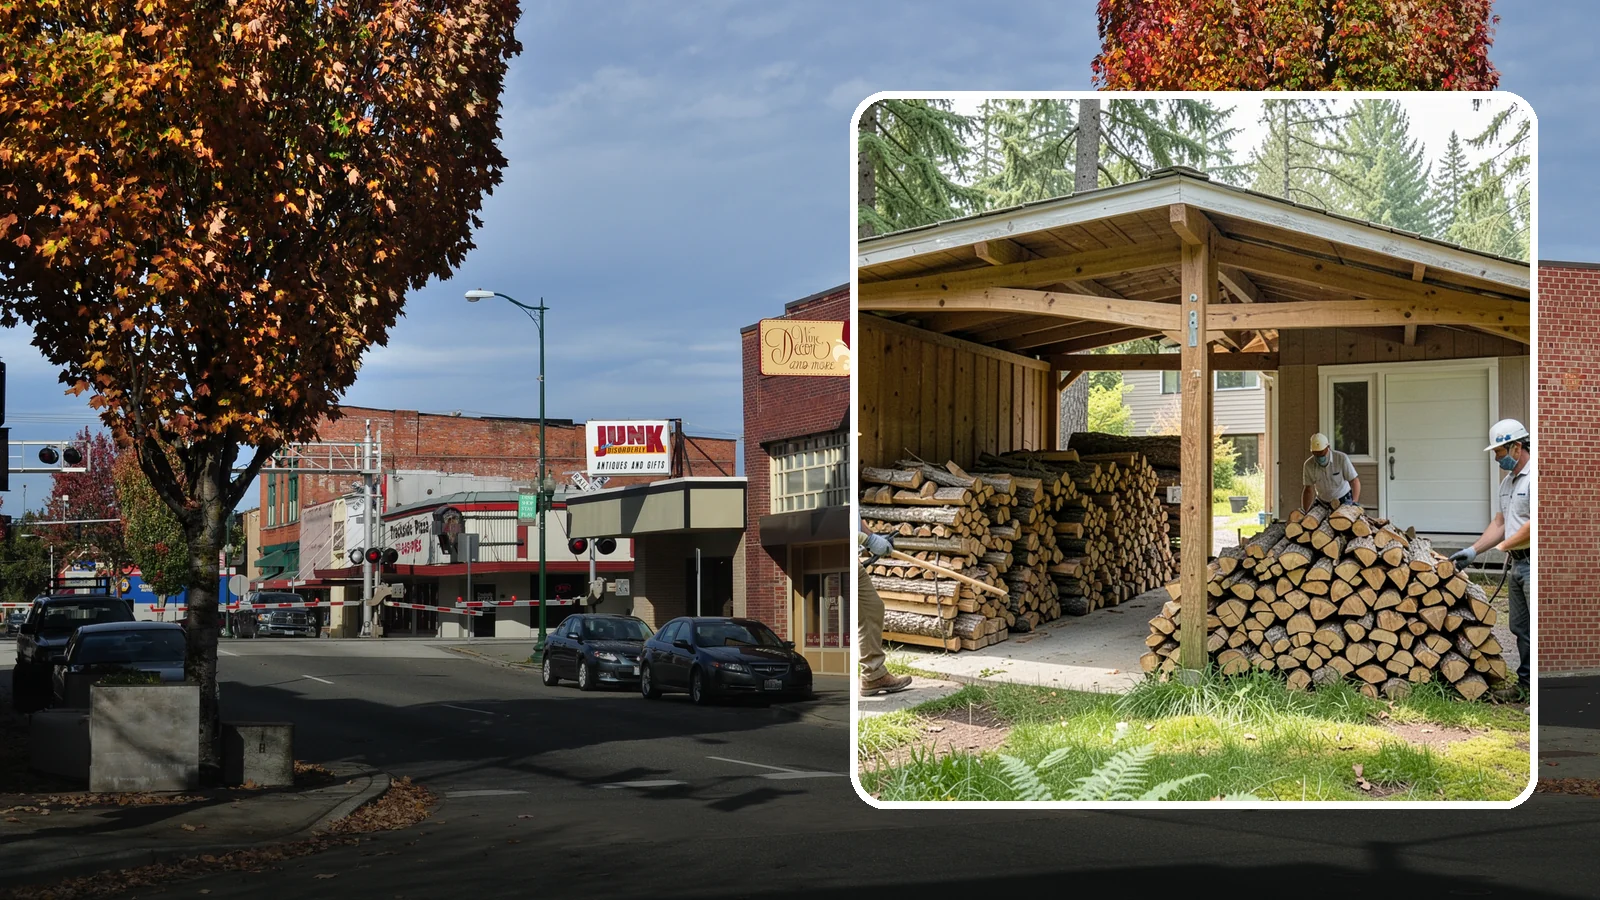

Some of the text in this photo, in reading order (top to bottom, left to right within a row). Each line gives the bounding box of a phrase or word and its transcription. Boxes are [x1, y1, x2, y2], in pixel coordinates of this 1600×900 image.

[595, 425, 664, 457] JUNK
[607, 445, 646, 454] DISORDERLY
[596, 461, 665, 470] ANTIQUES AND GIFTS
[414, 519, 429, 535] Pizza
